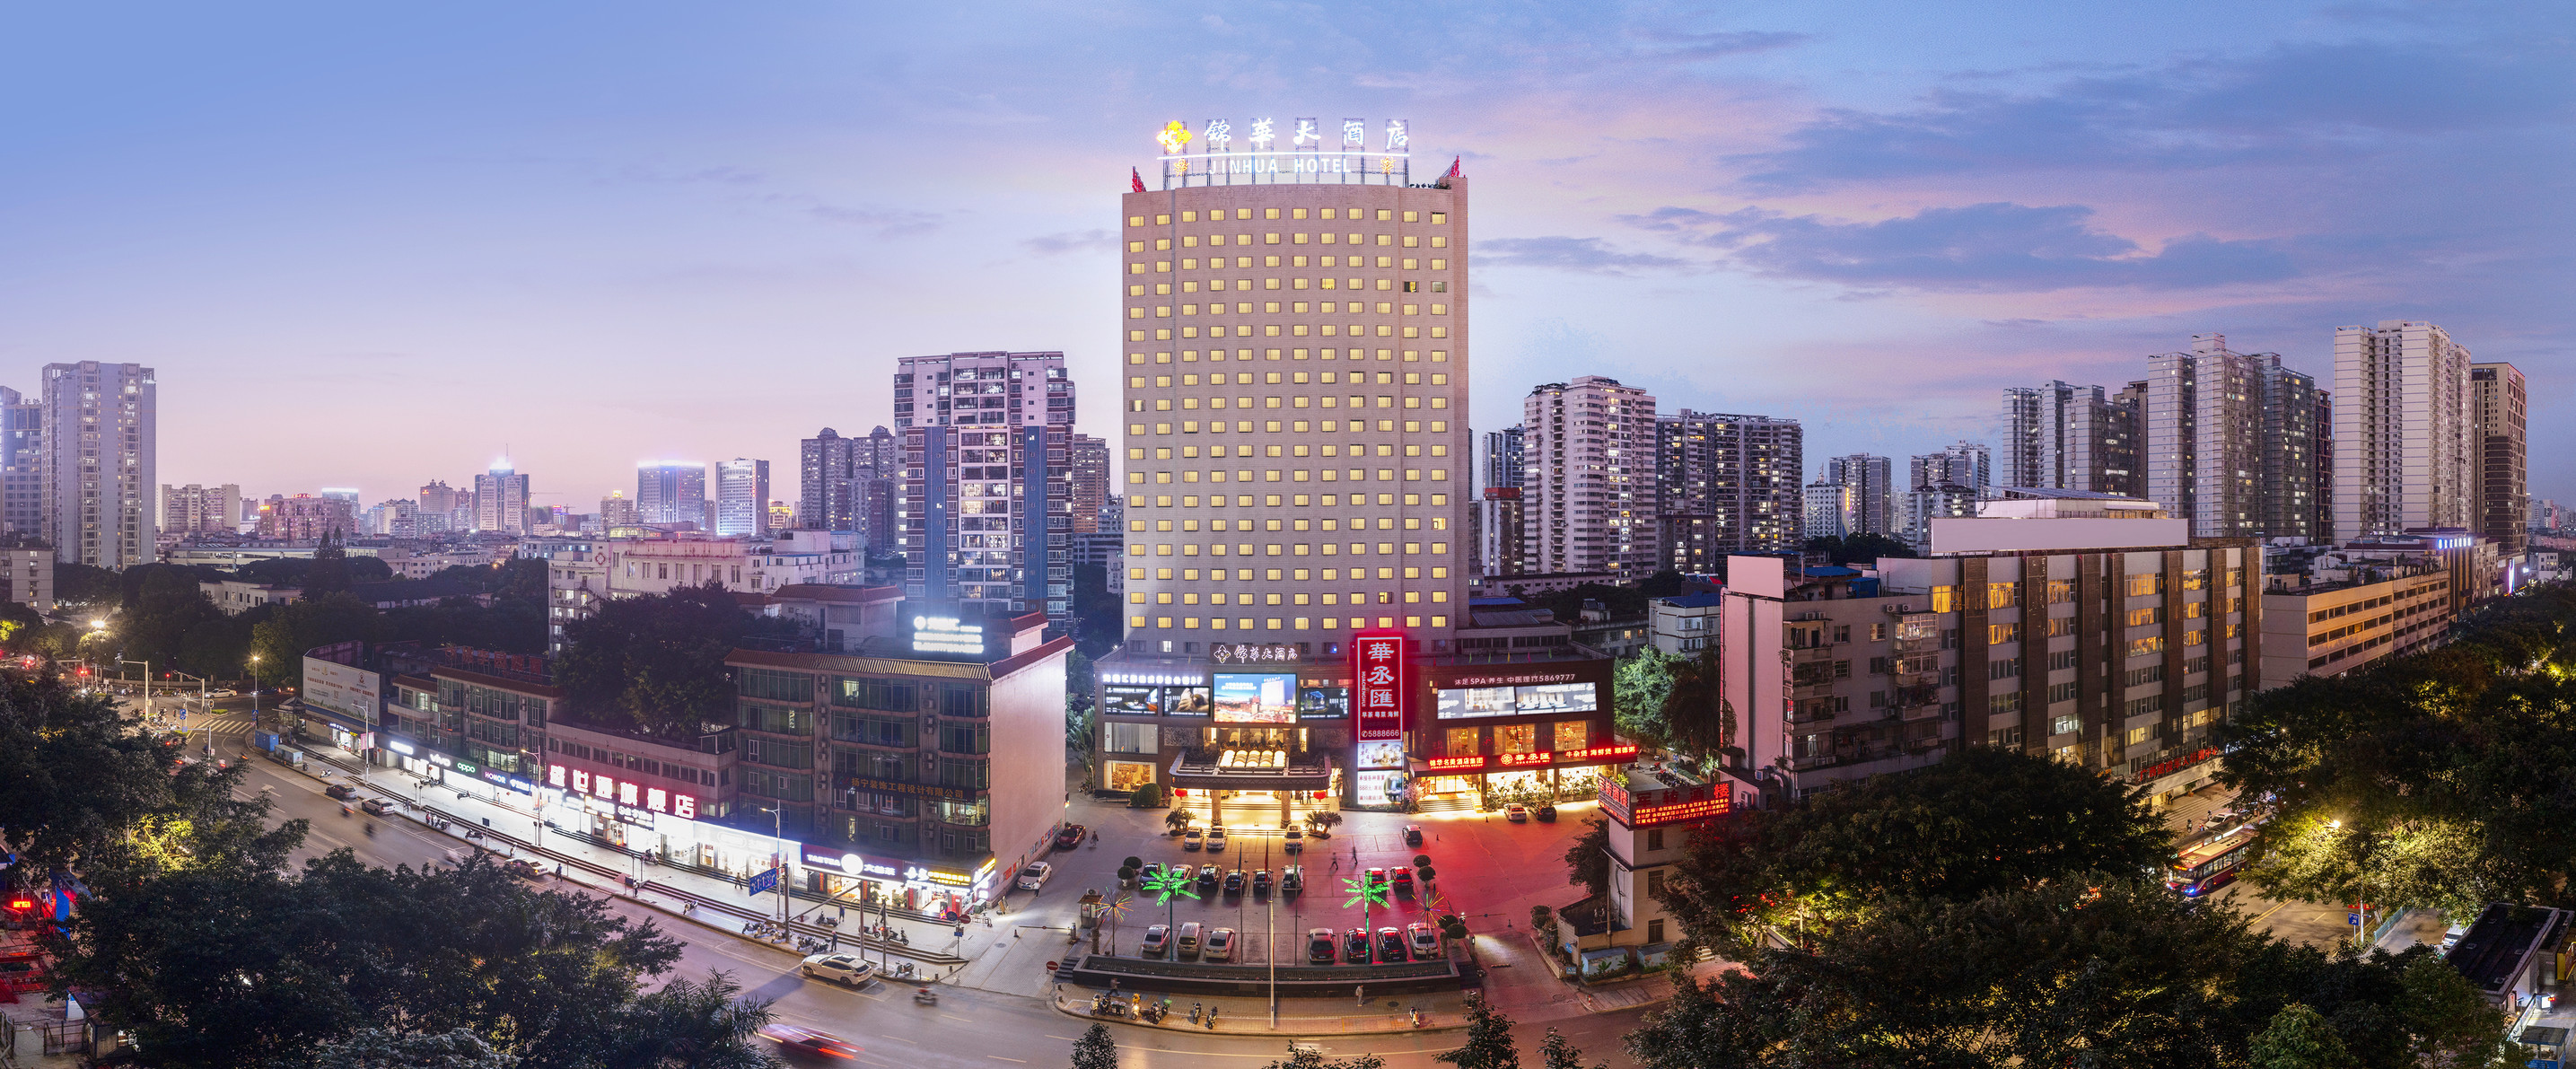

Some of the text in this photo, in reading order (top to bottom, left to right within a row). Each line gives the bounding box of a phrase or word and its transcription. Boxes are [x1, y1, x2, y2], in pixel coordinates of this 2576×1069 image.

[1209, 157, 1352, 174] JINHUA HOTEL
[485, 771, 506, 784] HONOR
